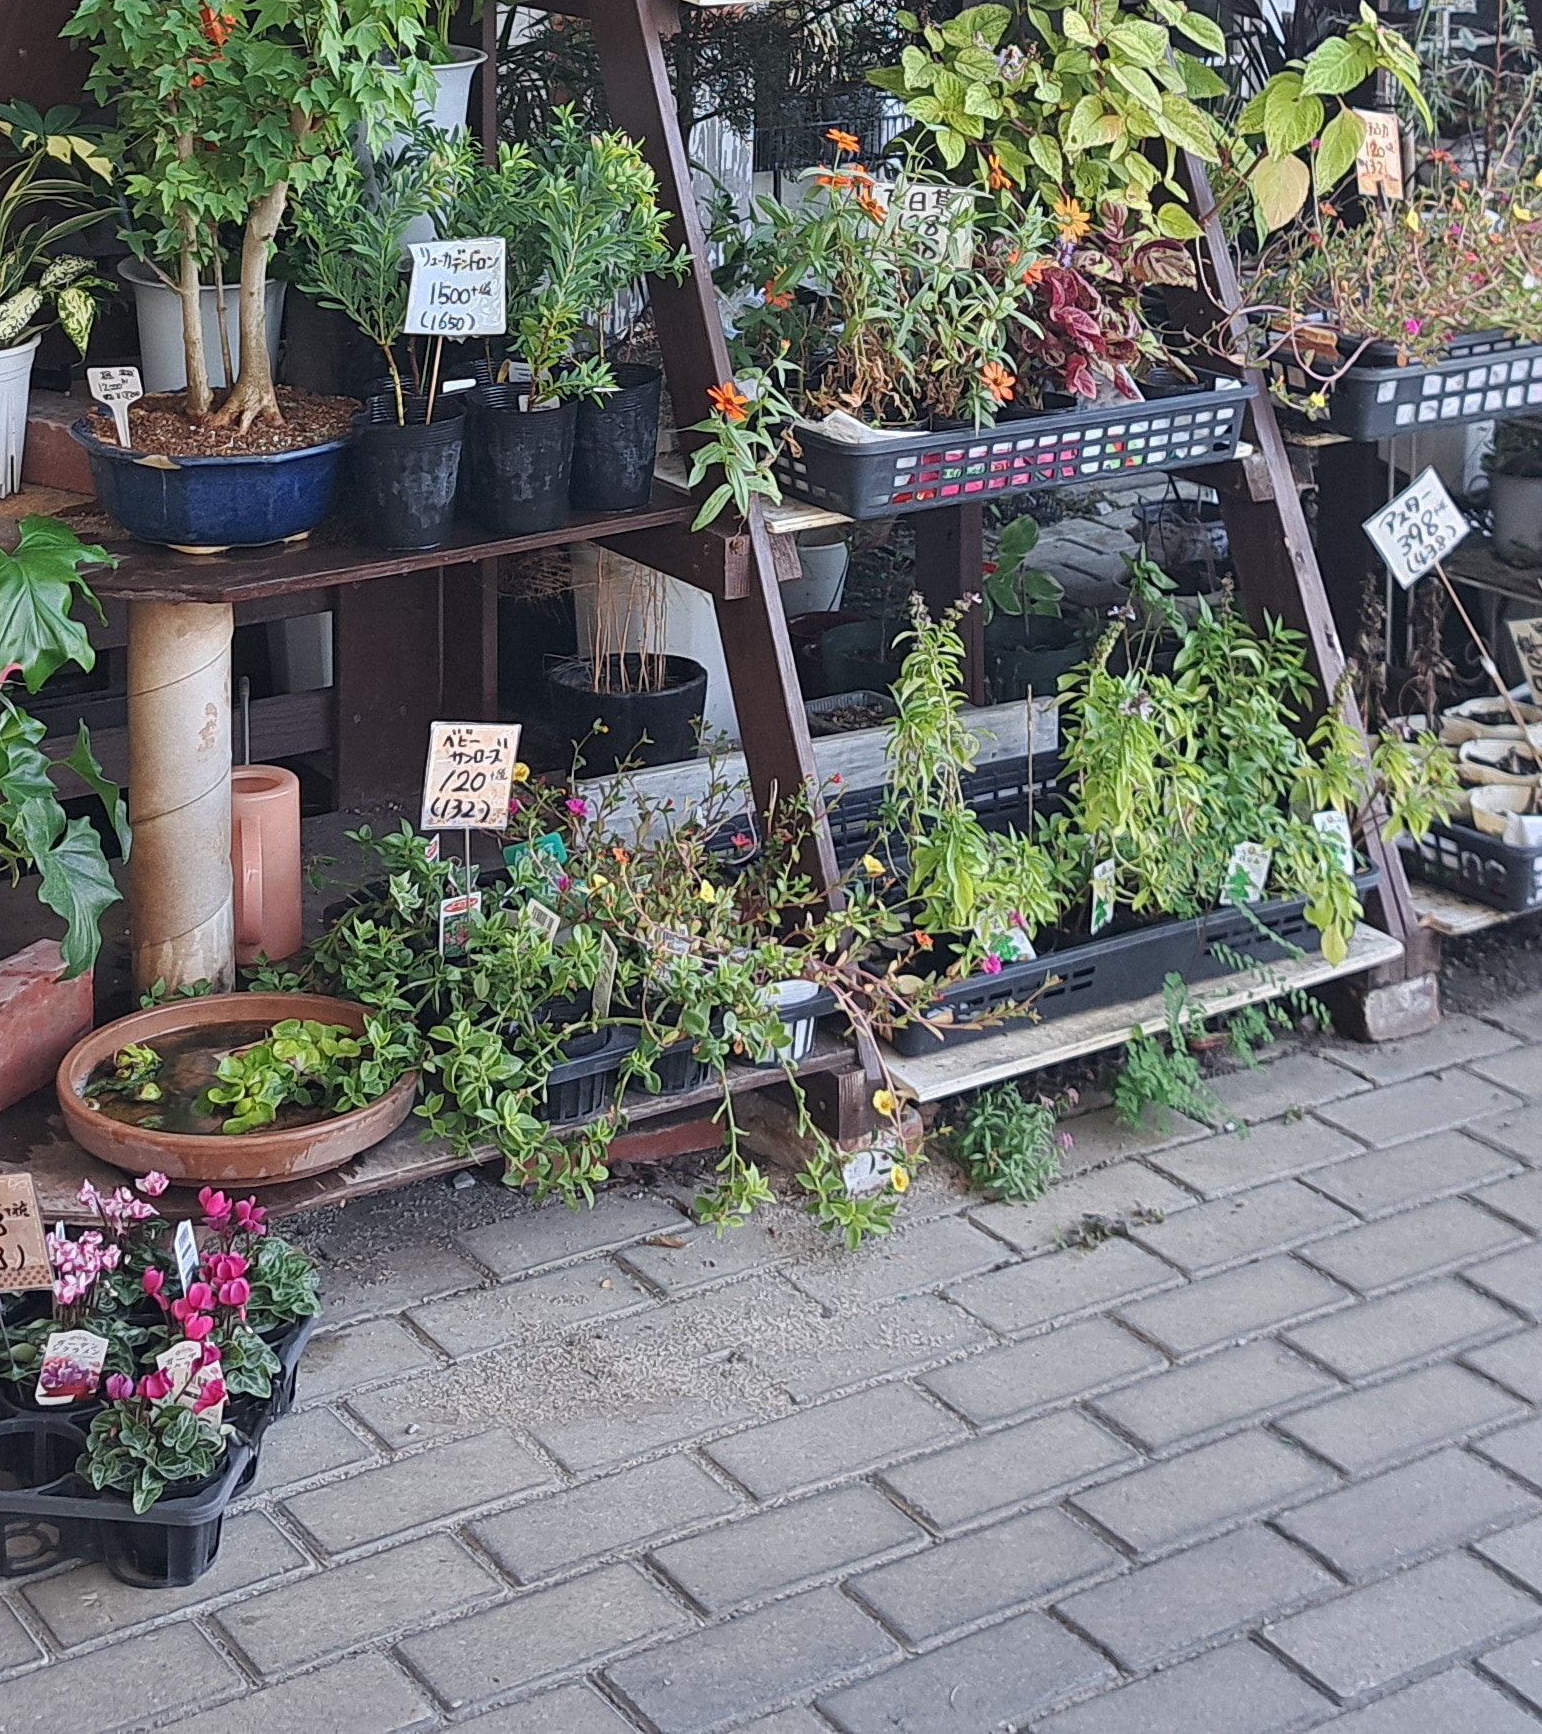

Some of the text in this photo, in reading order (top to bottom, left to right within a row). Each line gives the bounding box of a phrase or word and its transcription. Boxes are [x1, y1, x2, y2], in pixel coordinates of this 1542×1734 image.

[429, 281, 471, 306] 1500
[420, 311, 476, 331] (1650)
[1397, 509, 1439, 557] 398
[439, 770, 487, 793] 120
[431, 797, 491, 823] (132)
